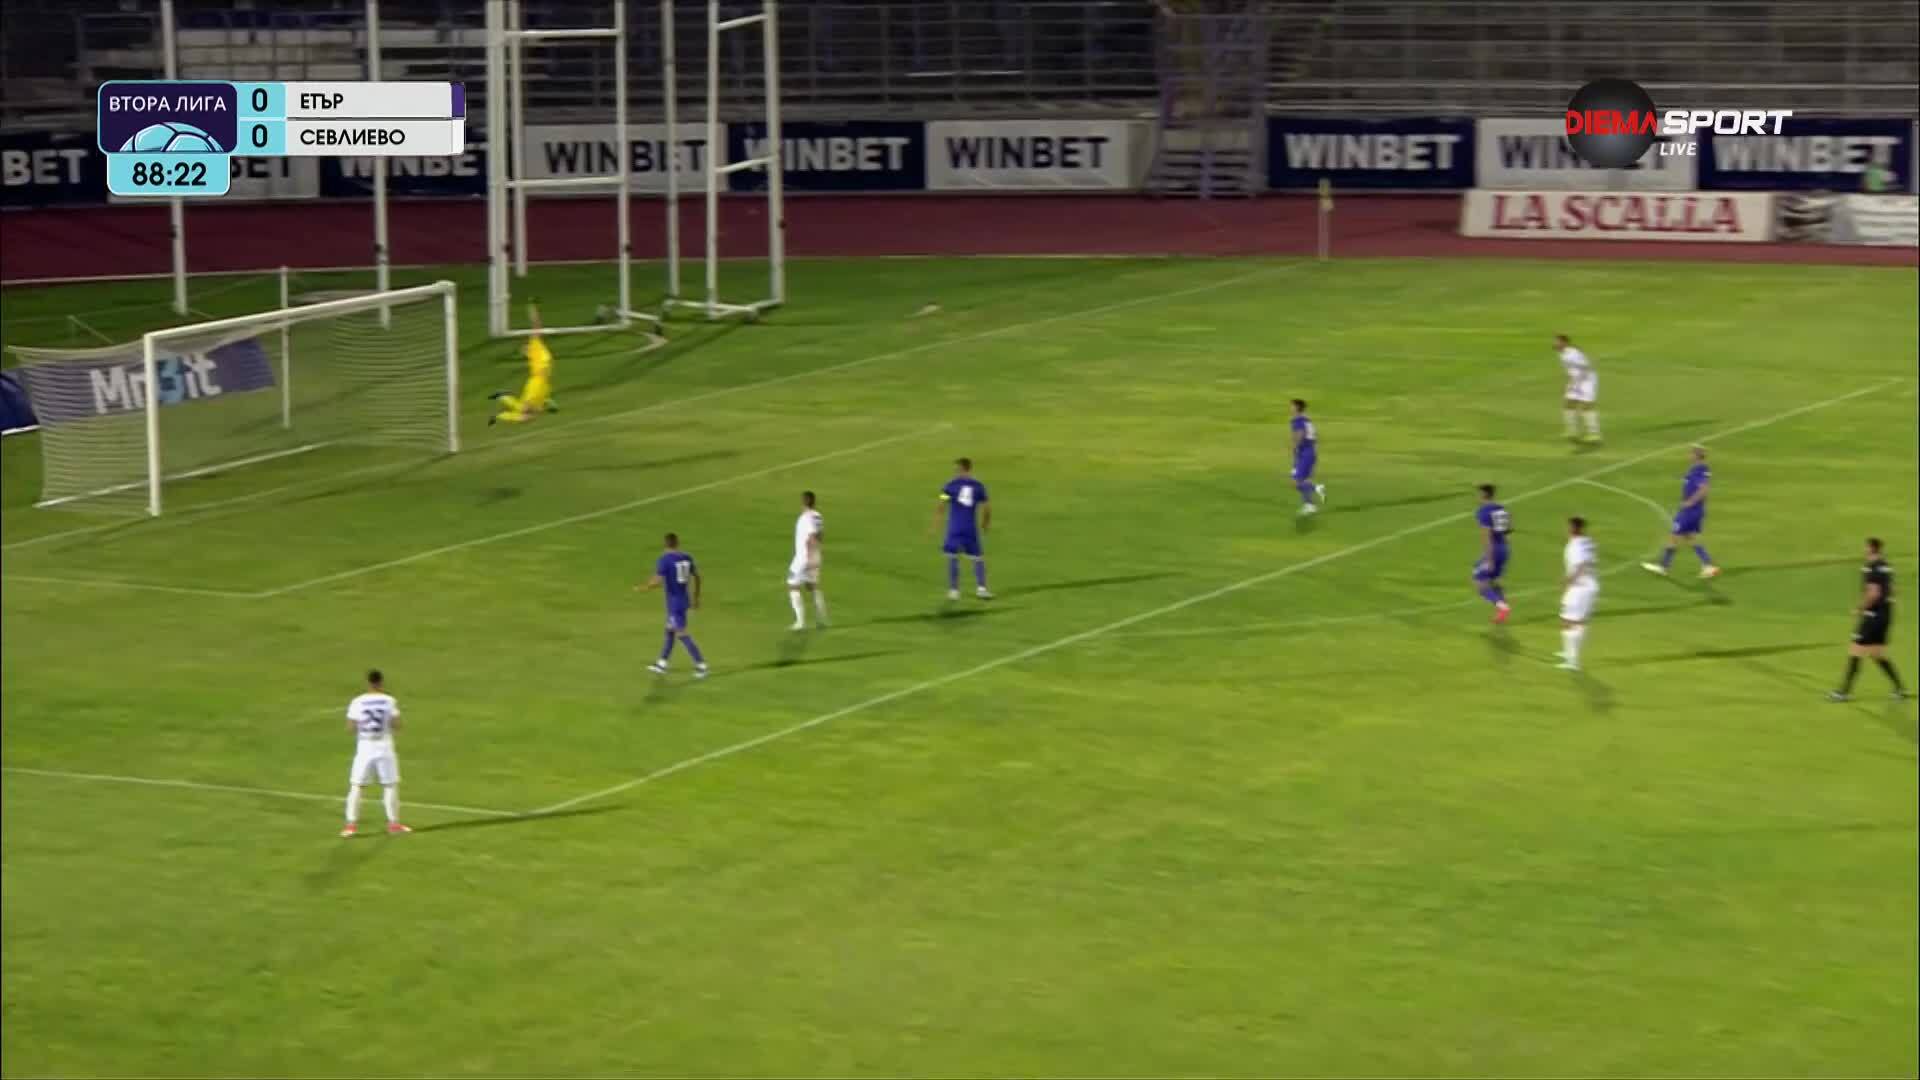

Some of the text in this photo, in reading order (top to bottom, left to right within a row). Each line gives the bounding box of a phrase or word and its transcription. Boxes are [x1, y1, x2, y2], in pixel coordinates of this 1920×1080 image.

[945, 136, 1110, 169] WINBET
[1283, 133, 1463, 170] WINBET
[1712, 135, 1902, 173] WINBET
[1489, 194, 1744, 233] LA SCALLA
